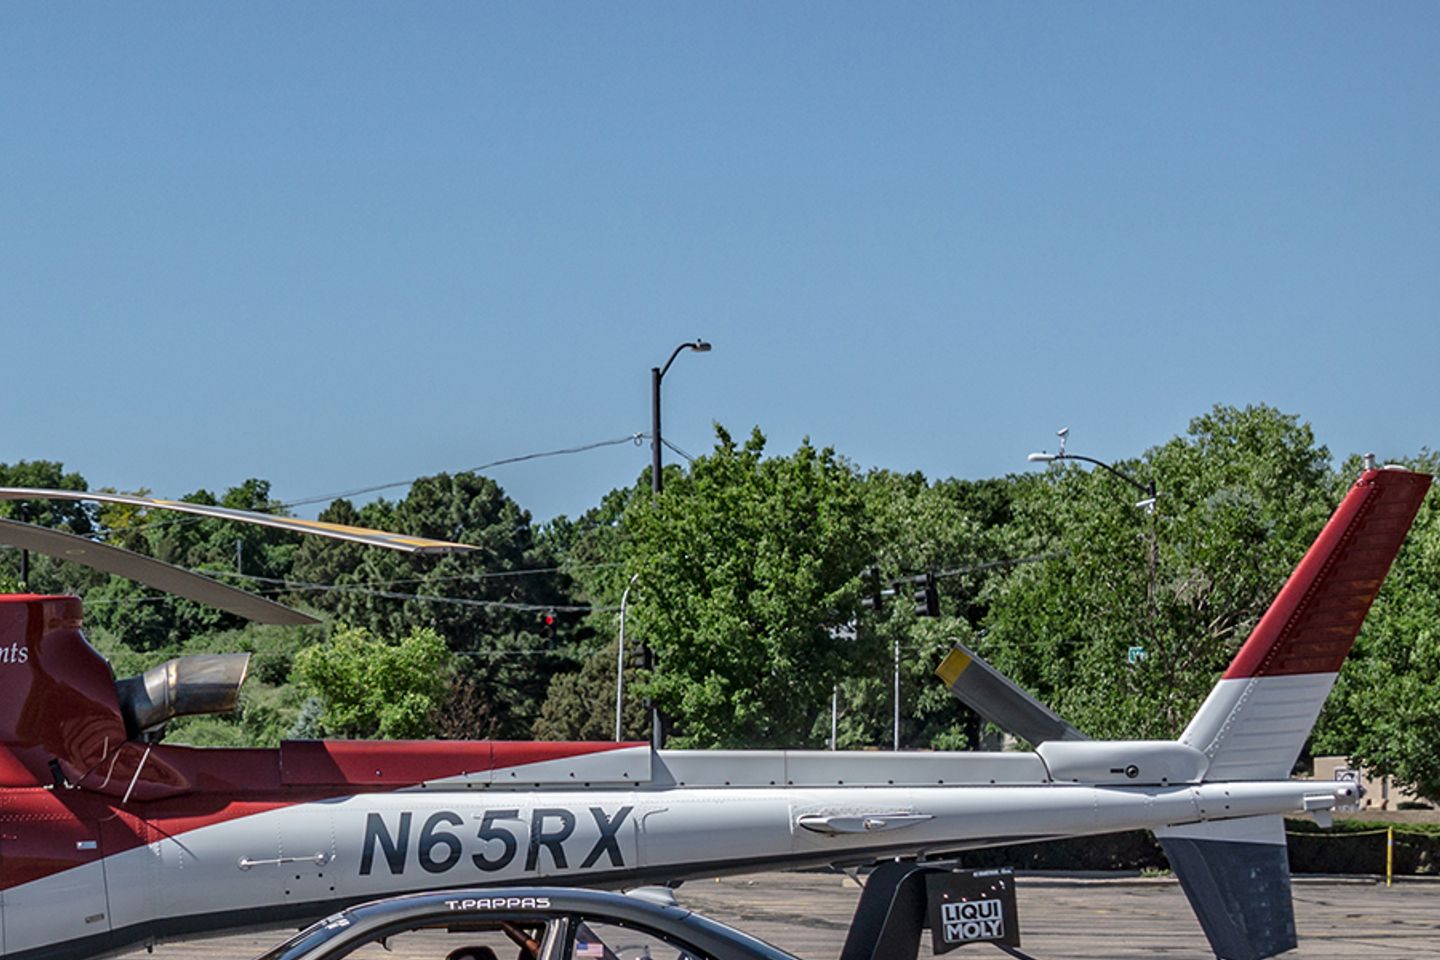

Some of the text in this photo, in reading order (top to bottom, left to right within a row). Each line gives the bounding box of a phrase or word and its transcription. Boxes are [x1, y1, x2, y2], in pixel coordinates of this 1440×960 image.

[359, 806, 634, 876] N65RX
[945, 902, 999, 921] LIQUI
[946, 920, 1001, 940] MOLY
